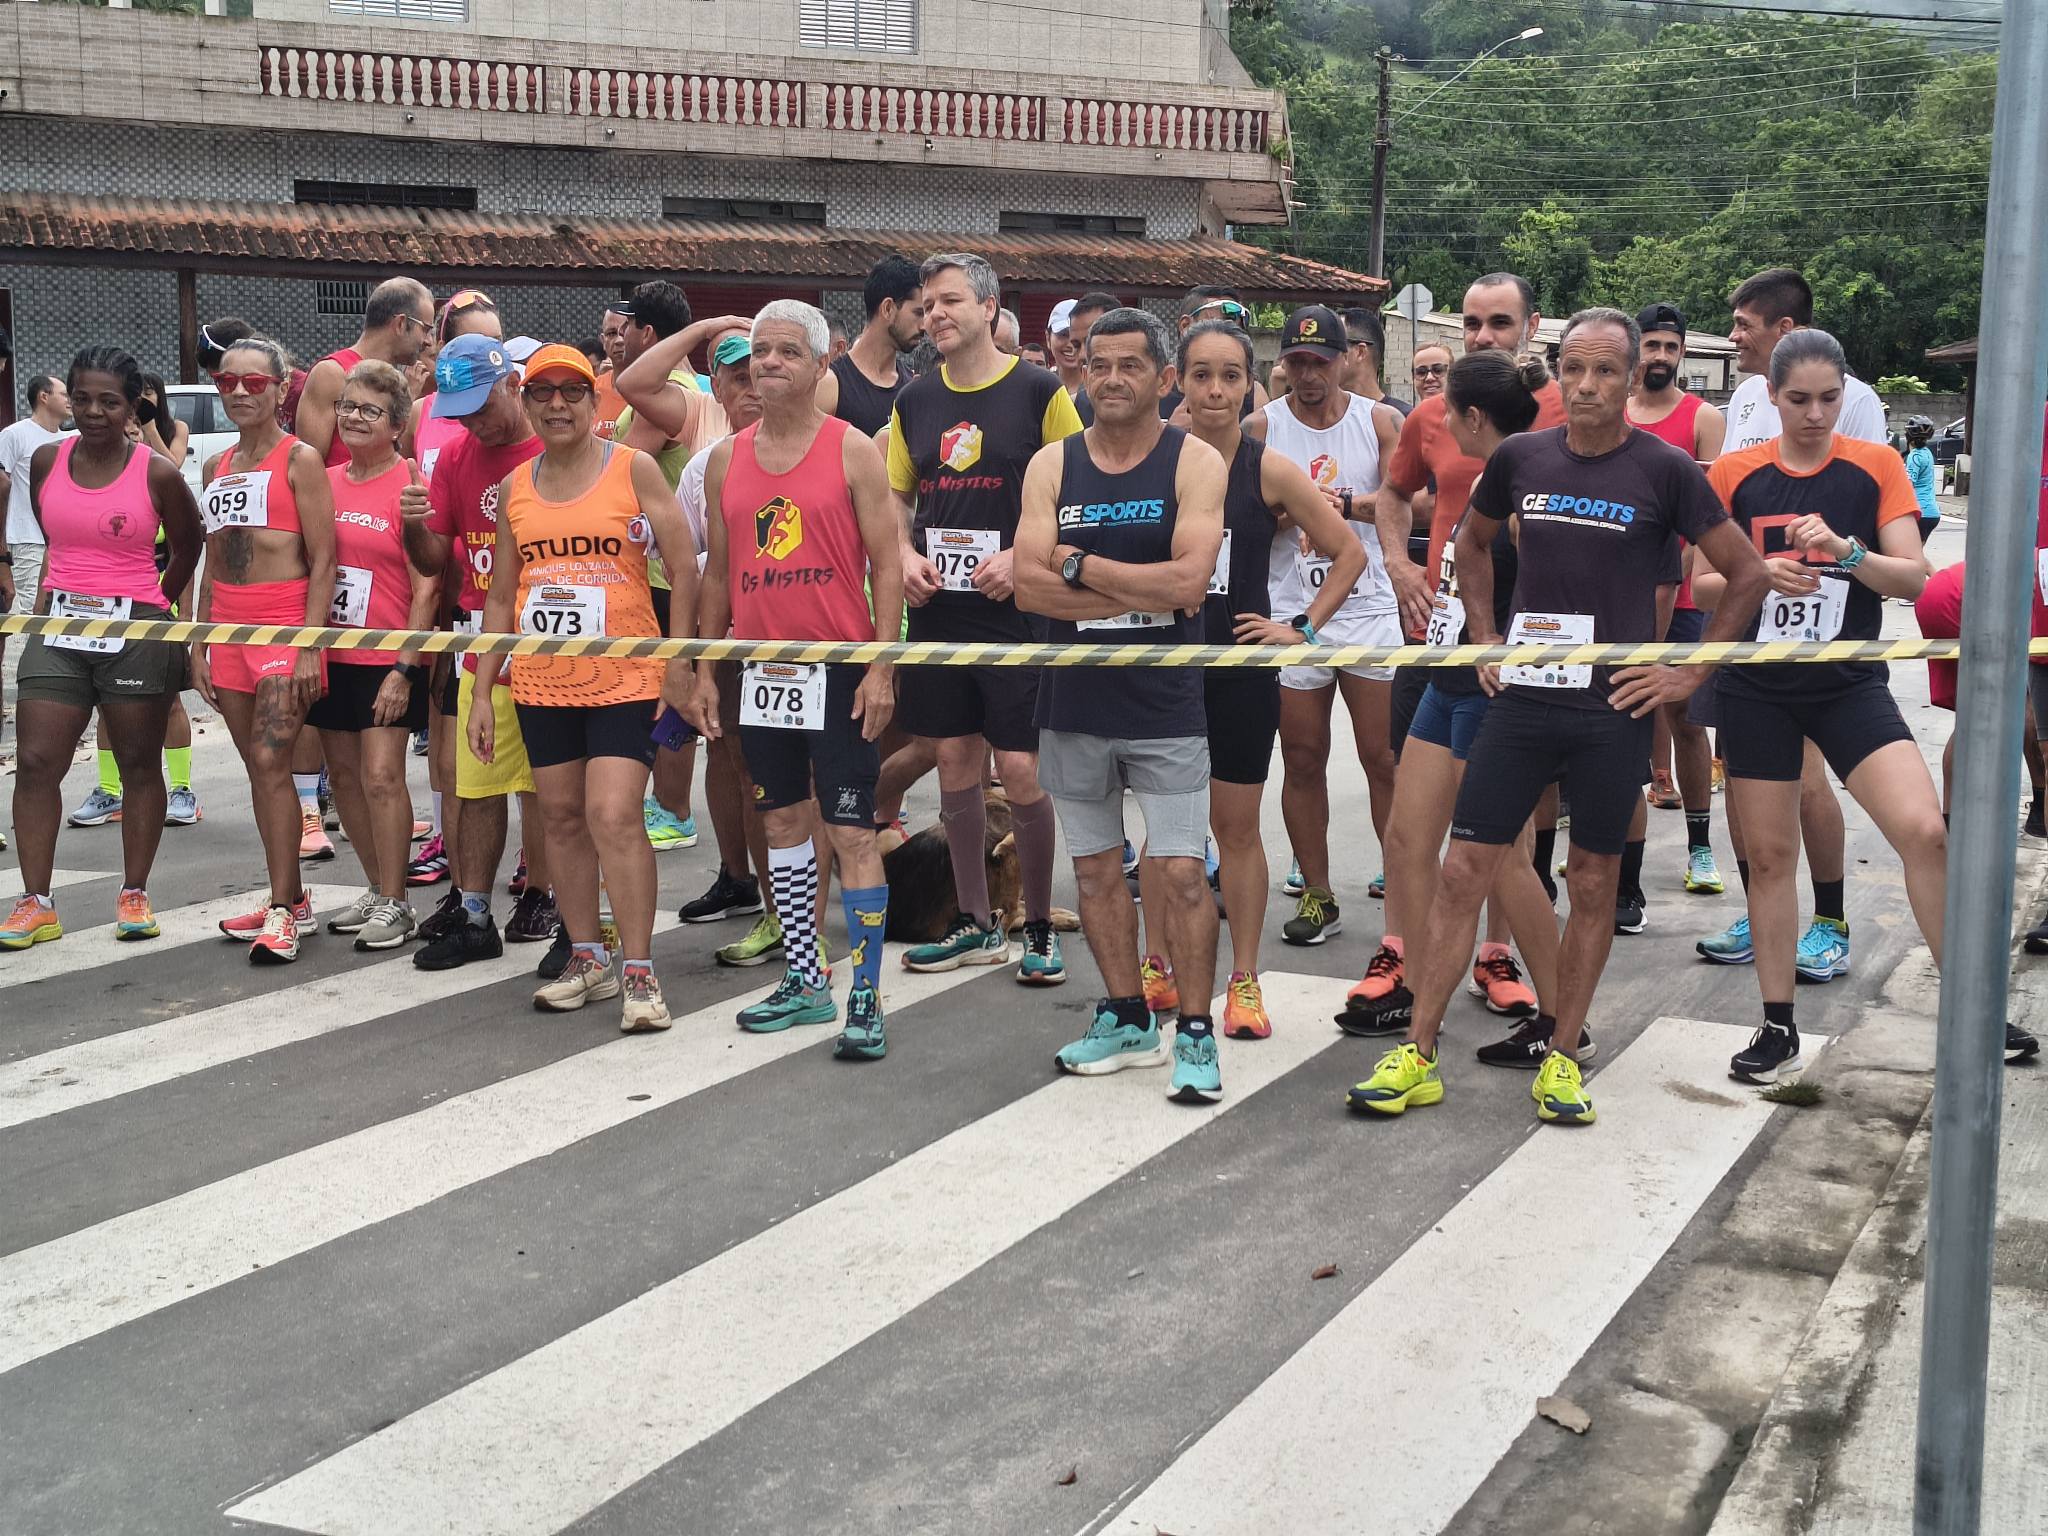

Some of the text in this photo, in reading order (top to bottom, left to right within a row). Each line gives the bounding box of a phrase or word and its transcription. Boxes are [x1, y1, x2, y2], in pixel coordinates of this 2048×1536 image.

[208, 491, 248, 516] 059
[519, 536, 622, 563] STUDIO
[935, 552, 979, 577] 079
[532, 610, 582, 635] 073
[1774, 601, 1822, 628] 031
[755, 685, 803, 712] 078
